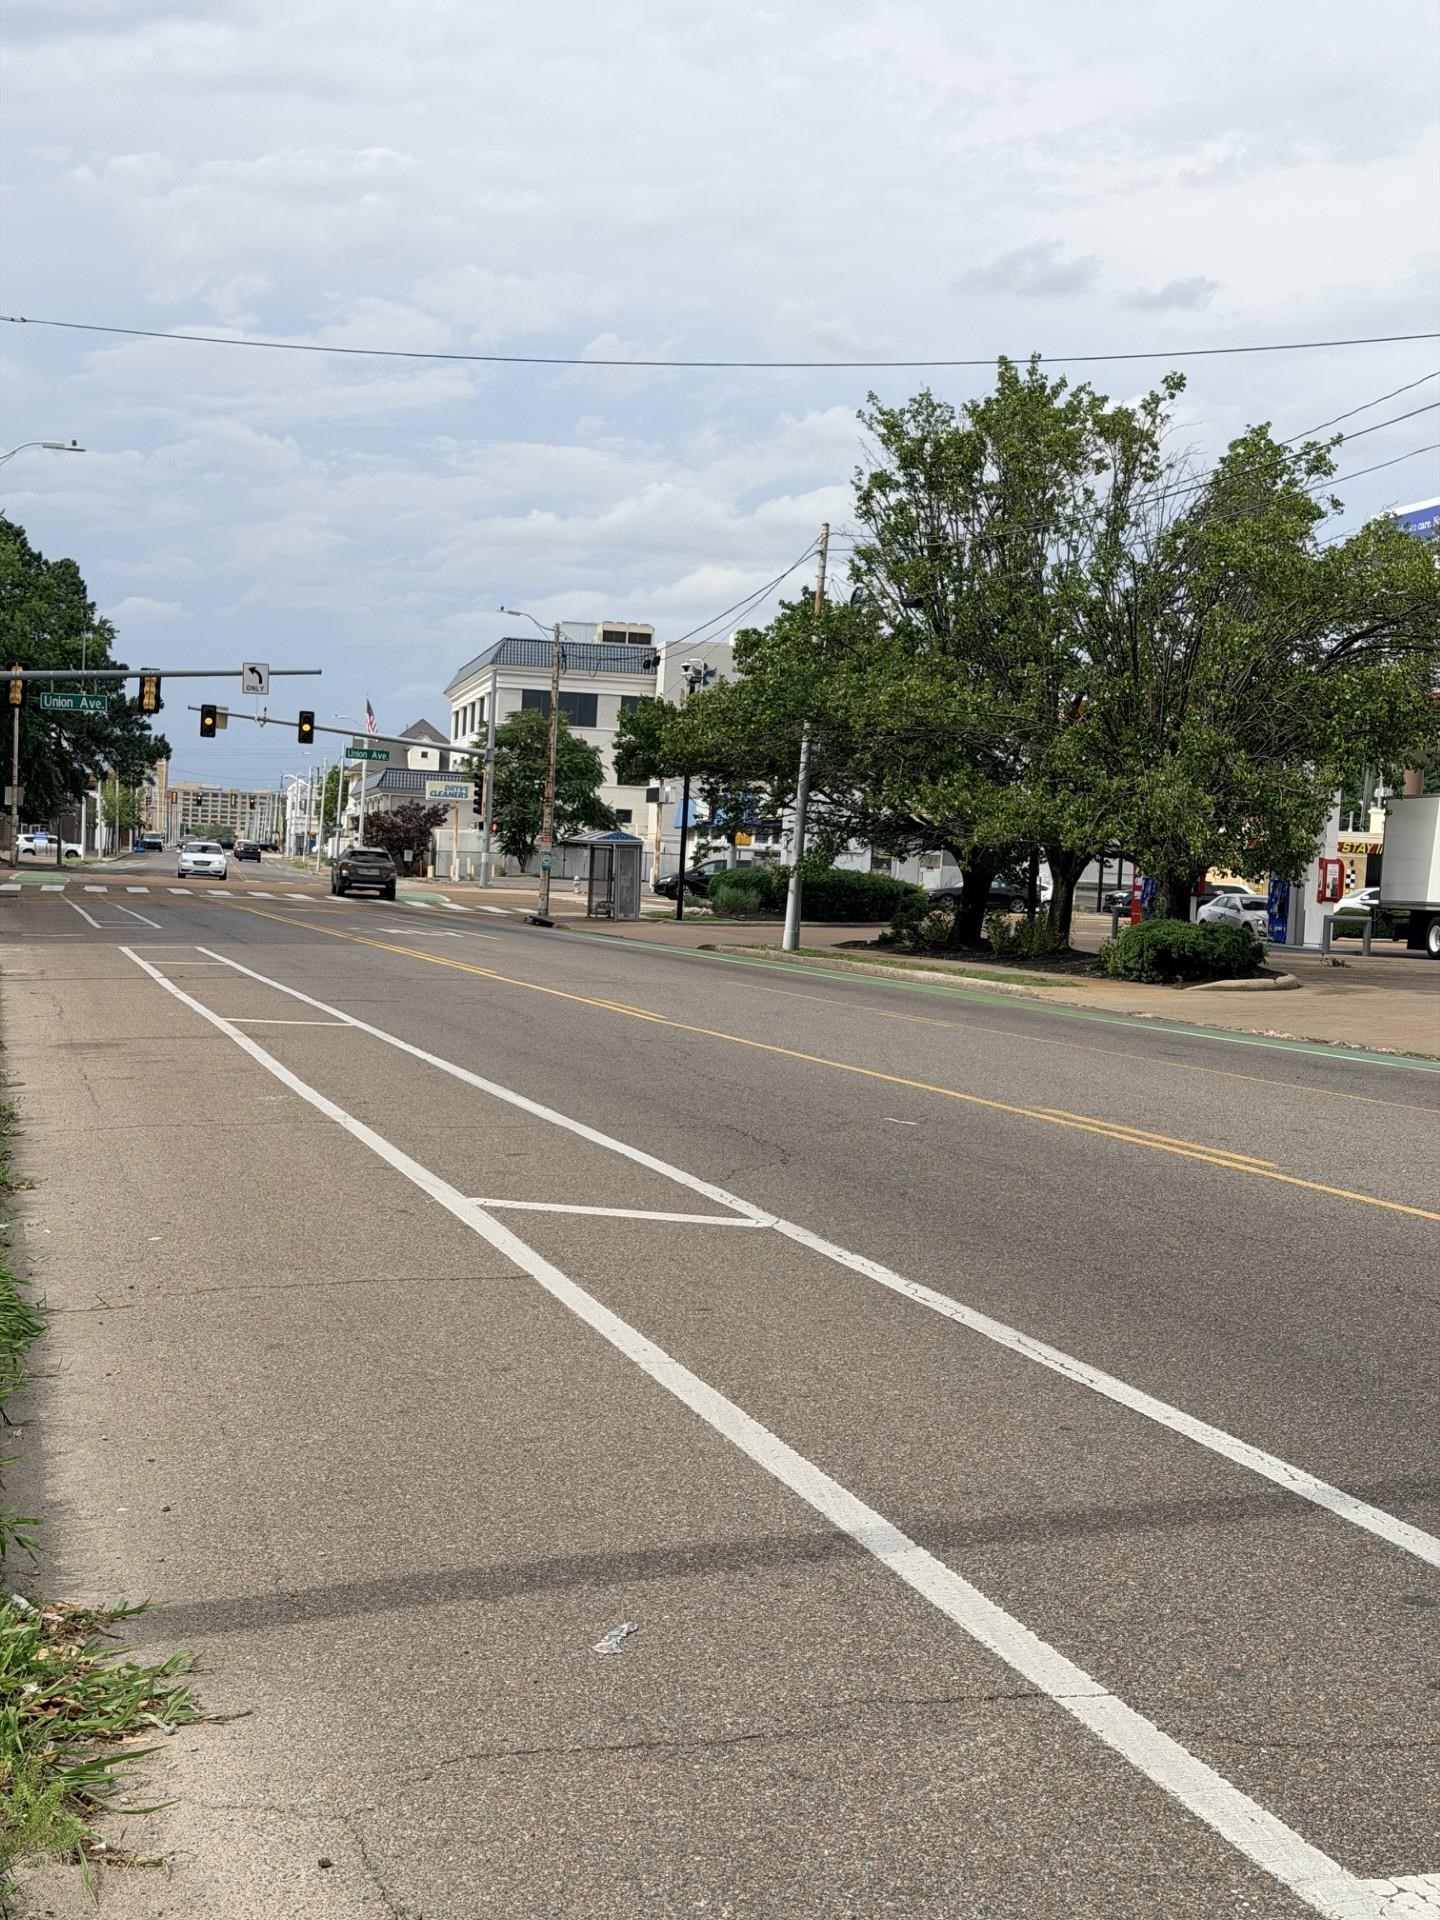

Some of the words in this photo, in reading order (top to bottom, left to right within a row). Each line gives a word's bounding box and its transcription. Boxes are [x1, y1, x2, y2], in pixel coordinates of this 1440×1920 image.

[246, 684, 264, 692] ONLY
[44, 695, 73, 708] Union
[80, 696, 105, 709] Ave.
[347, 750, 368, 759] Union
[430, 790, 468, 799] CLEANERS
[1341, 842, 1373, 854] STAY
